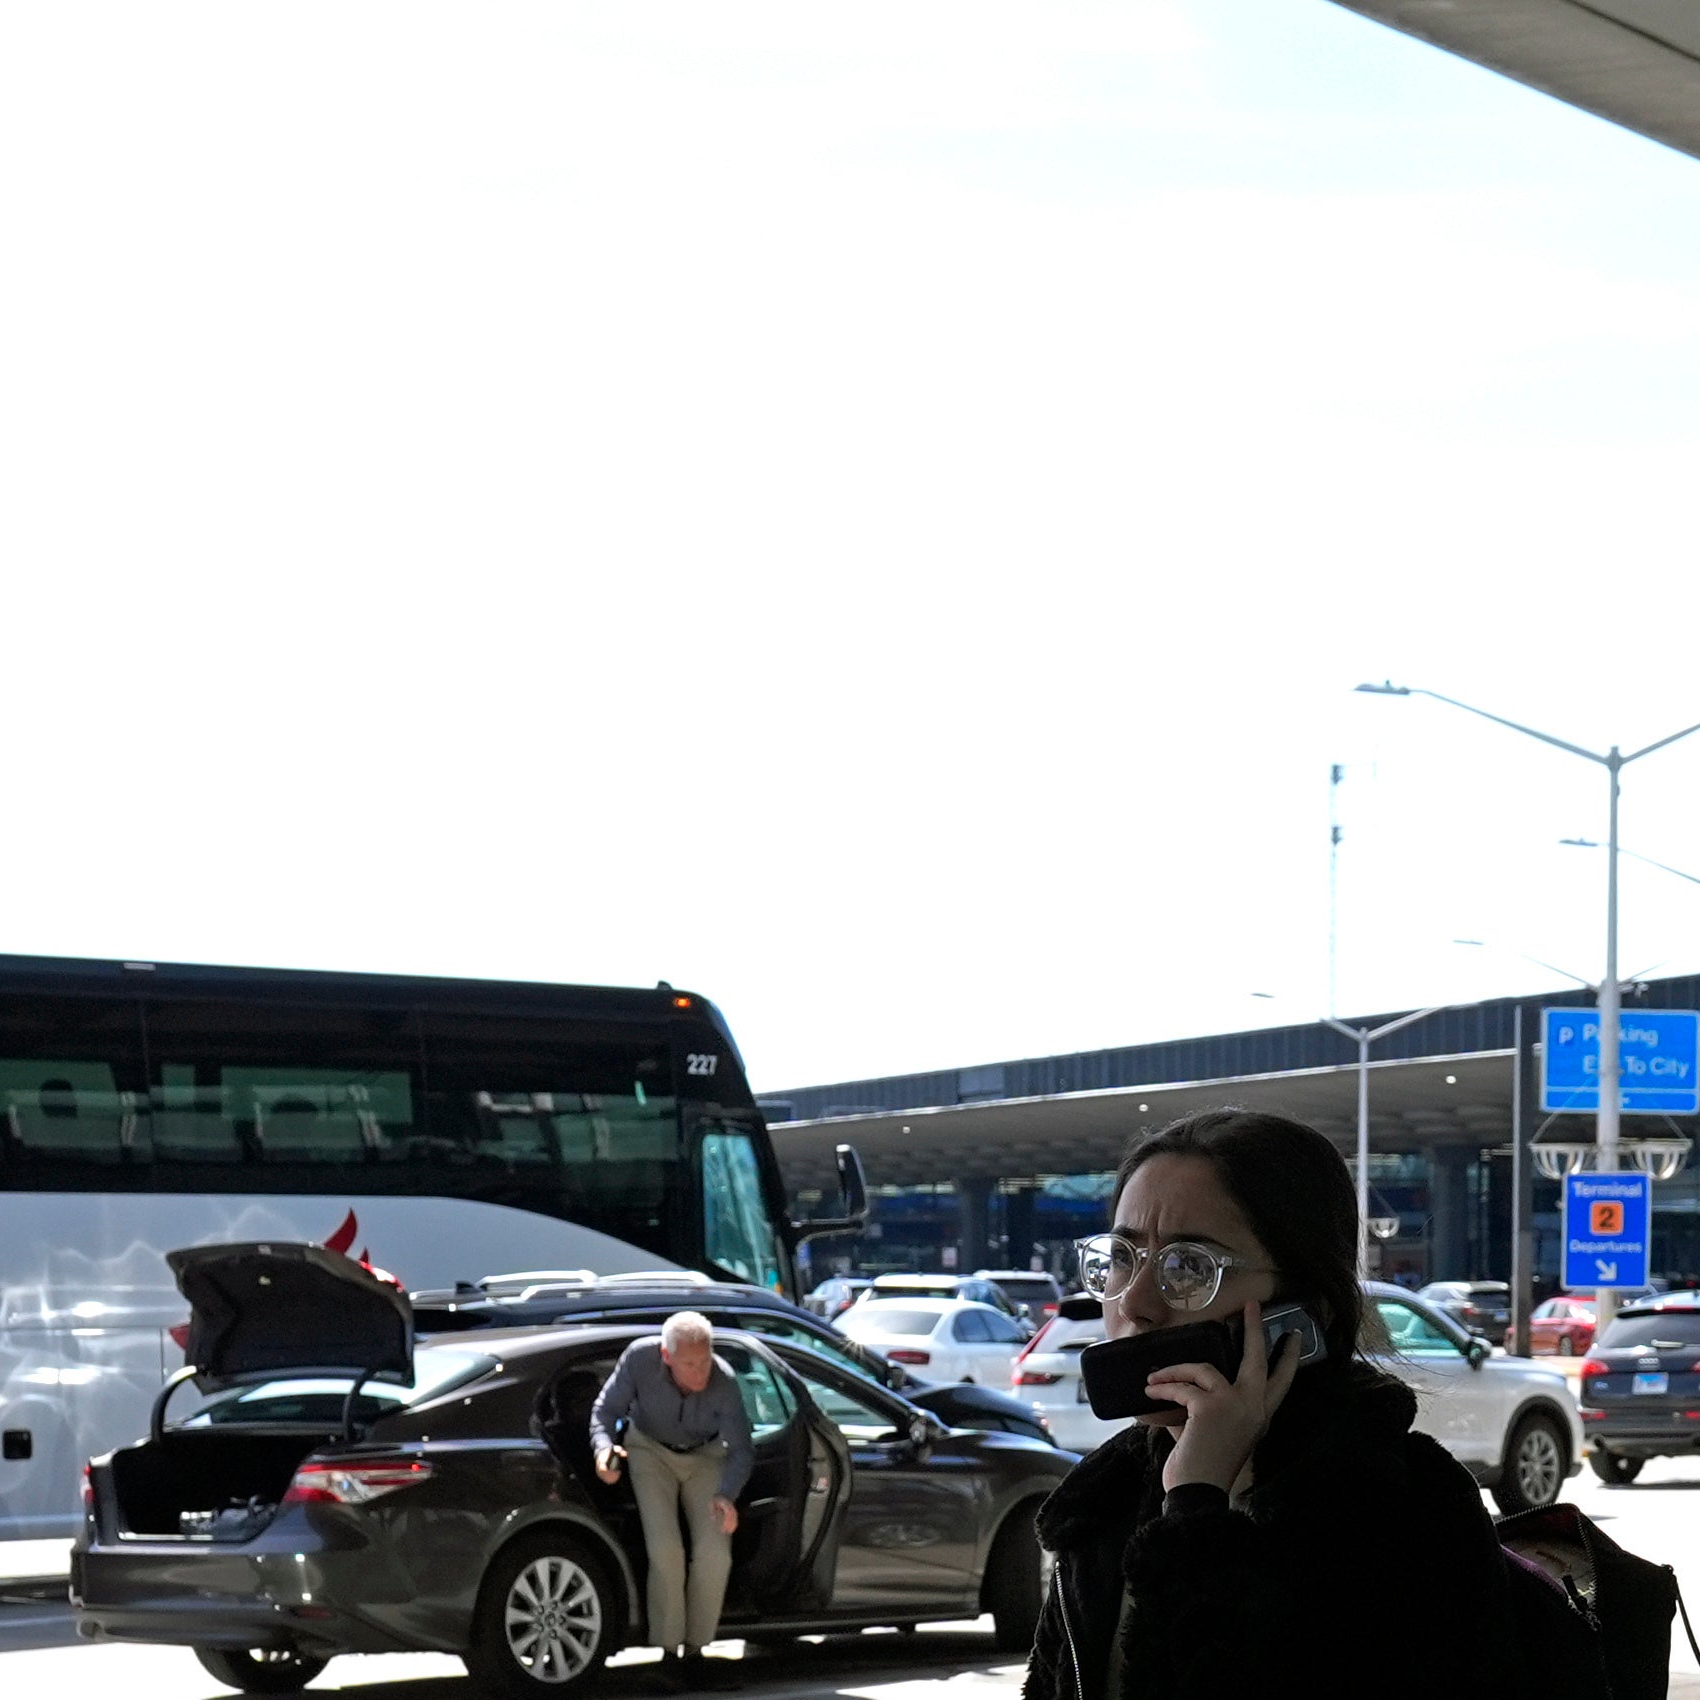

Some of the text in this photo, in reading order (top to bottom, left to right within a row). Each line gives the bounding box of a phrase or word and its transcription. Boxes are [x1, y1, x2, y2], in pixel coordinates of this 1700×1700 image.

[1583, 1023, 1658, 1048] Pking
[687, 1053, 717, 1077] 227
[1625, 1055, 1646, 1075] To
[1650, 1057, 1689, 1079] City
[1572, 1181, 1643, 1198] Terminal
[1599, 1206, 1614, 1228] 2
[1569, 1239, 1643, 1254] Departures
